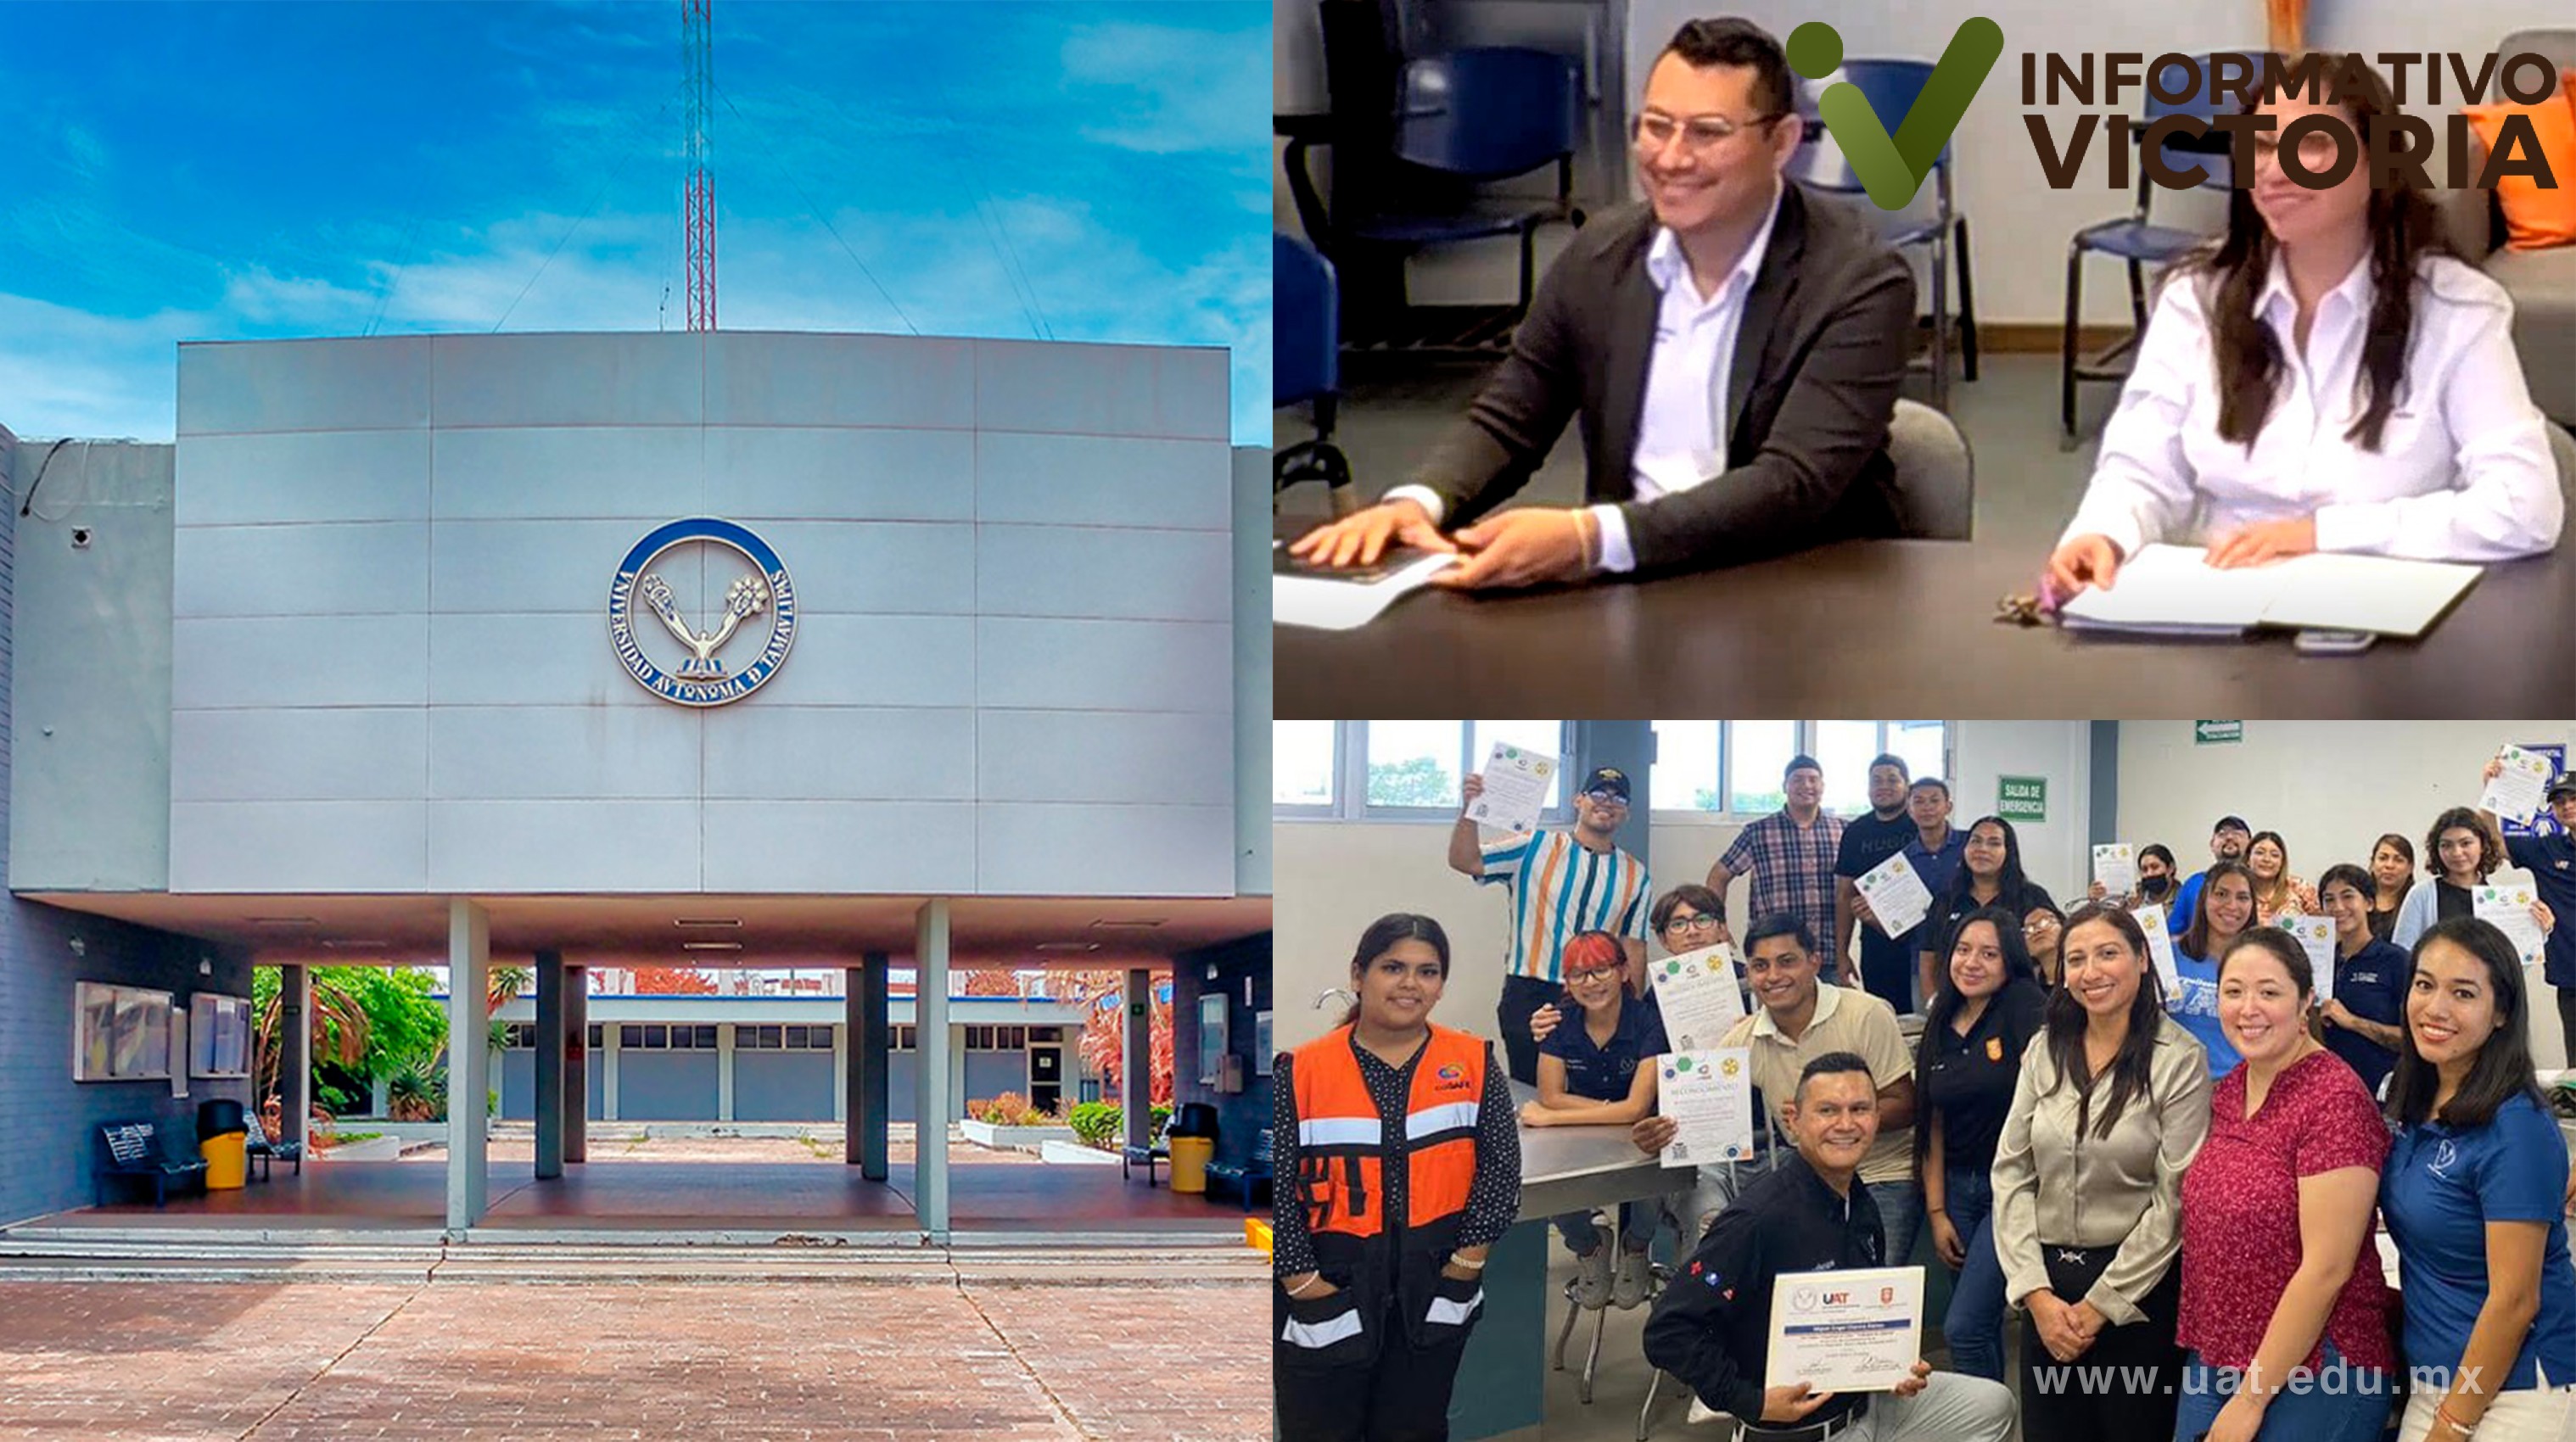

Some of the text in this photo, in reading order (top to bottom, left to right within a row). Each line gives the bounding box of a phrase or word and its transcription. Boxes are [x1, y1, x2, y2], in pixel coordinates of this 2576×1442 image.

[2004, 784, 2041, 798] SALIDA DE
[2000, 800, 2043, 813] EMERGENCIA
[1823, 1292, 1850, 1305] UAT
